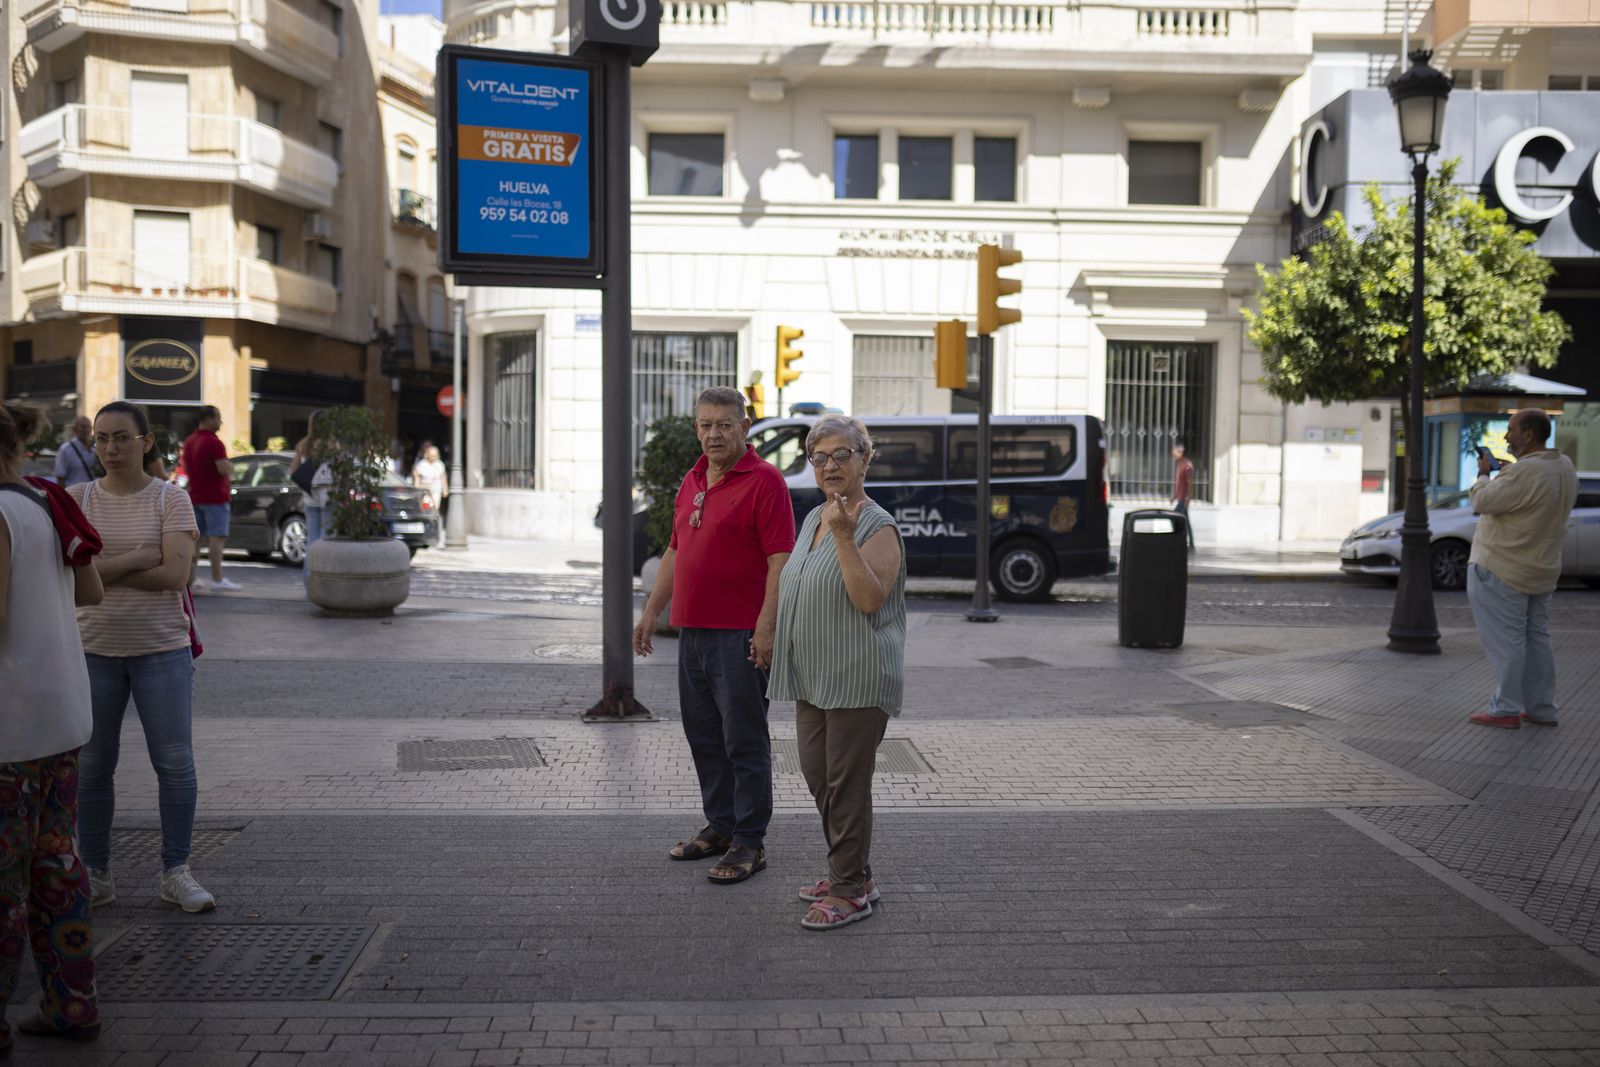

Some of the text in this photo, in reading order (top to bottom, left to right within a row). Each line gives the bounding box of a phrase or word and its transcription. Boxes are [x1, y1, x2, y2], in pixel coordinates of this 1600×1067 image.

[466, 79, 580, 100] VITALDENT
[483, 129, 565, 144] PRIMERA VISITA
[483, 140, 566, 162] GRATIS
[499, 181, 550, 195] HUELVA
[480, 207, 569, 225] 959 54 02 08
[897, 523, 968, 537] ONAL
